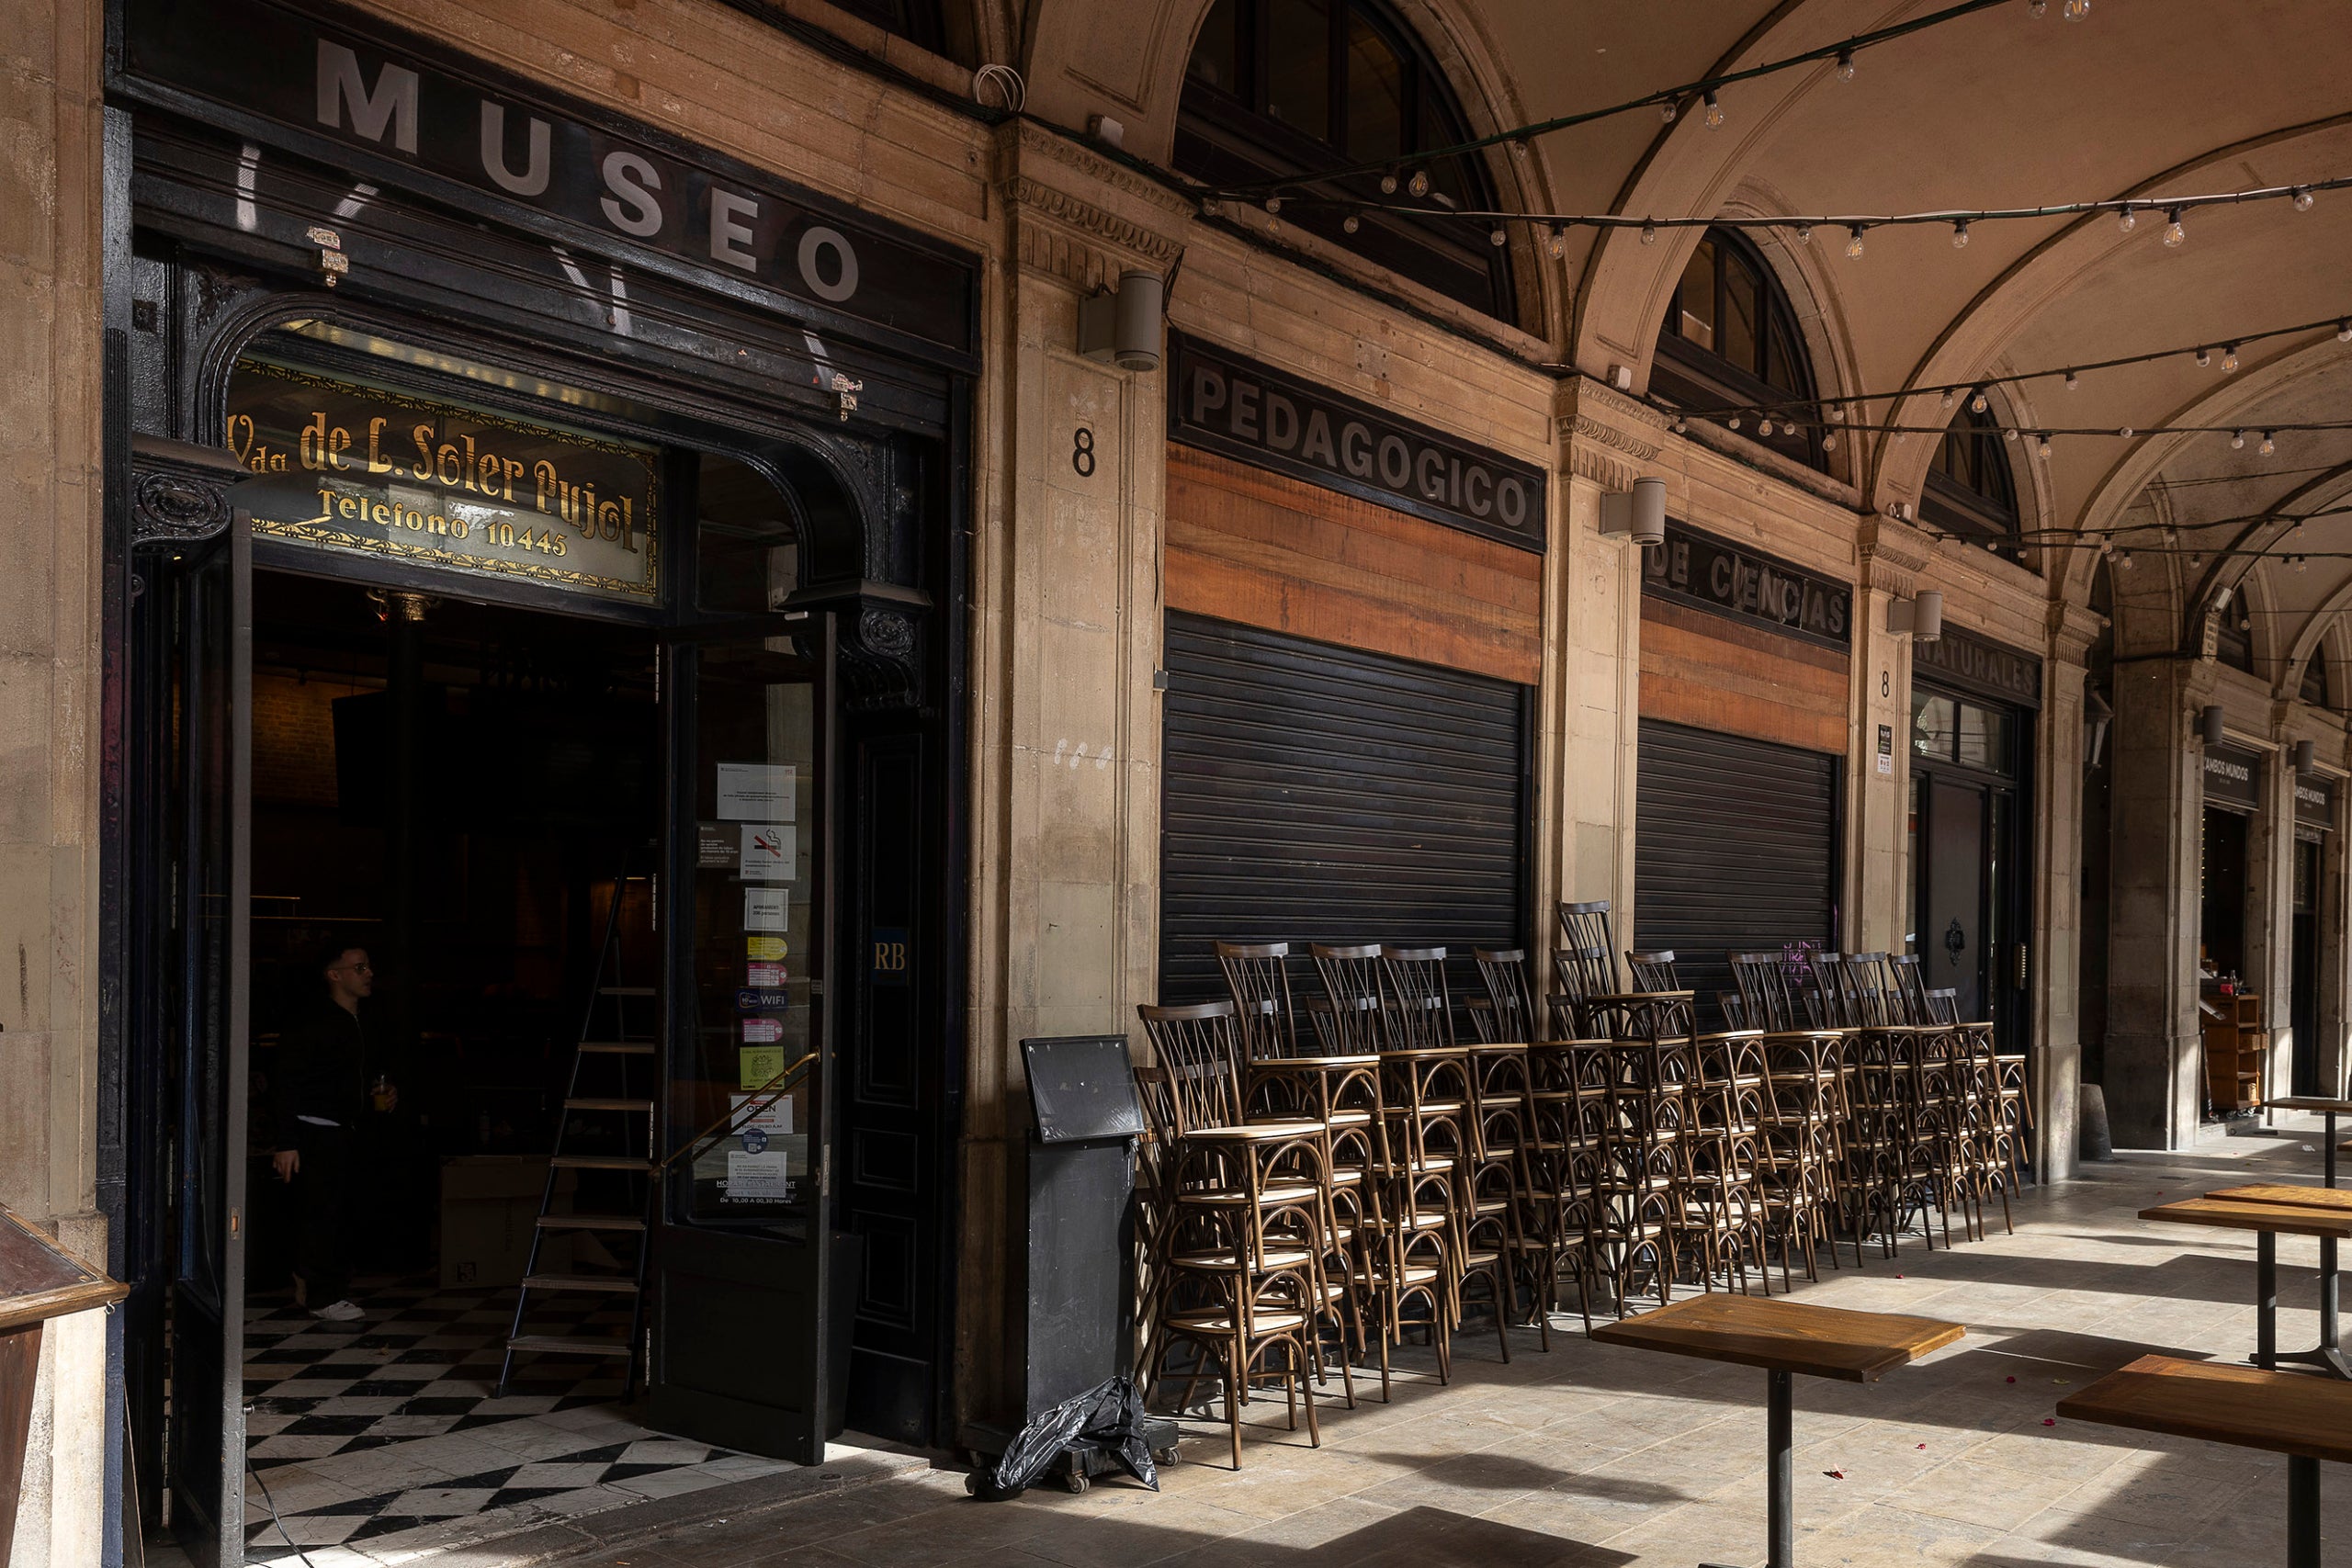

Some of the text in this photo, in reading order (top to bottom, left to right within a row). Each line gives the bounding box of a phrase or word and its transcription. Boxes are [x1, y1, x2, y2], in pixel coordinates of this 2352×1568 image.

[317, 38, 860, 302] MUSEO
[1072, 427, 1095, 477] 8
[1194, 369, 1527, 526] PEDAGOGICO
[227, 412, 639, 553] Vda de L. Soler Pujol
[487, 521, 568, 557] 10445
[1646, 540, 1845, 635] DE CIENCIAS
[1881, 670, 1890, 698] 8
[1915, 637, 2036, 696] NATURALES
[2225, 762, 2249, 782] MUNDOS
[874, 942, 906, 971] RB
[760, 995, 785, 1005] WIFI
